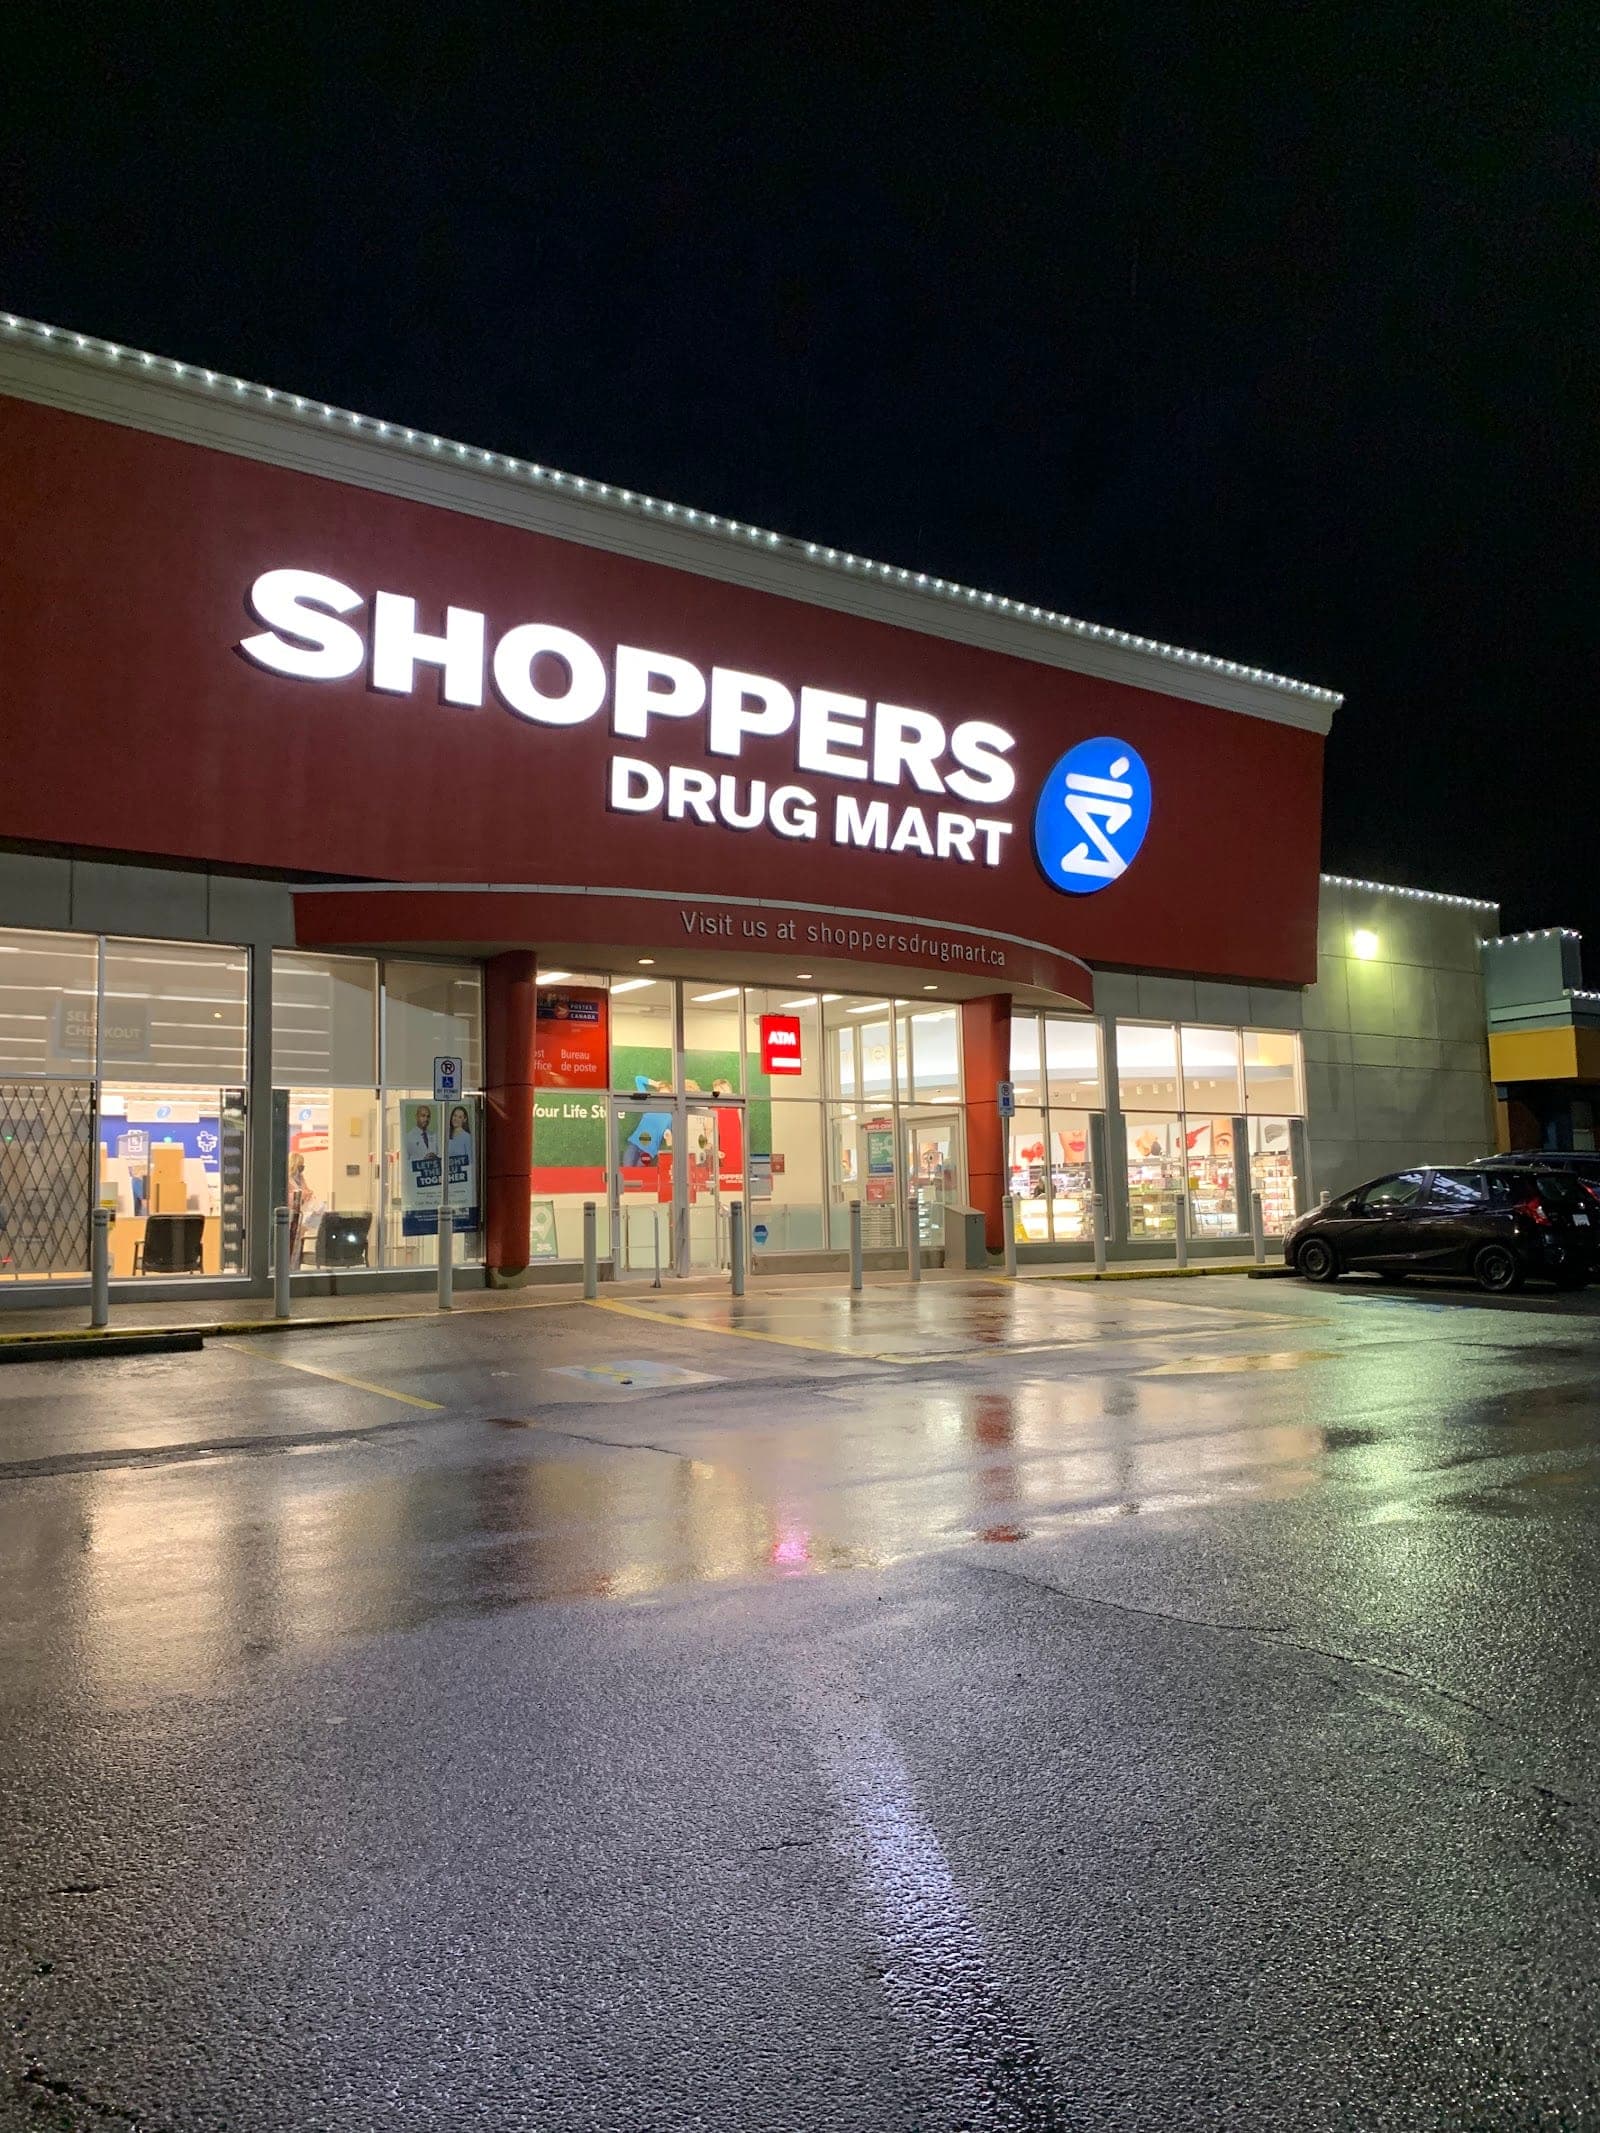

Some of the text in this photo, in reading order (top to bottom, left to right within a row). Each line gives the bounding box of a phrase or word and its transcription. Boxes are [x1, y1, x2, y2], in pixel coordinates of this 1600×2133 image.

[238, 567, 1017, 804] SHOPPERS
[610, 754, 1015, 867] DRUG MART
[681, 911, 1006, 967] Visit us at shoppersdrugmart.ca
[65, 1025, 142, 1039] CHEKOUT
[767, 1031, 797, 1046] ATM
[560, 1048, 590, 1060] Bureau
[560, 1061, 598, 1074] de poste
[563, 1103, 588, 1119] Life
